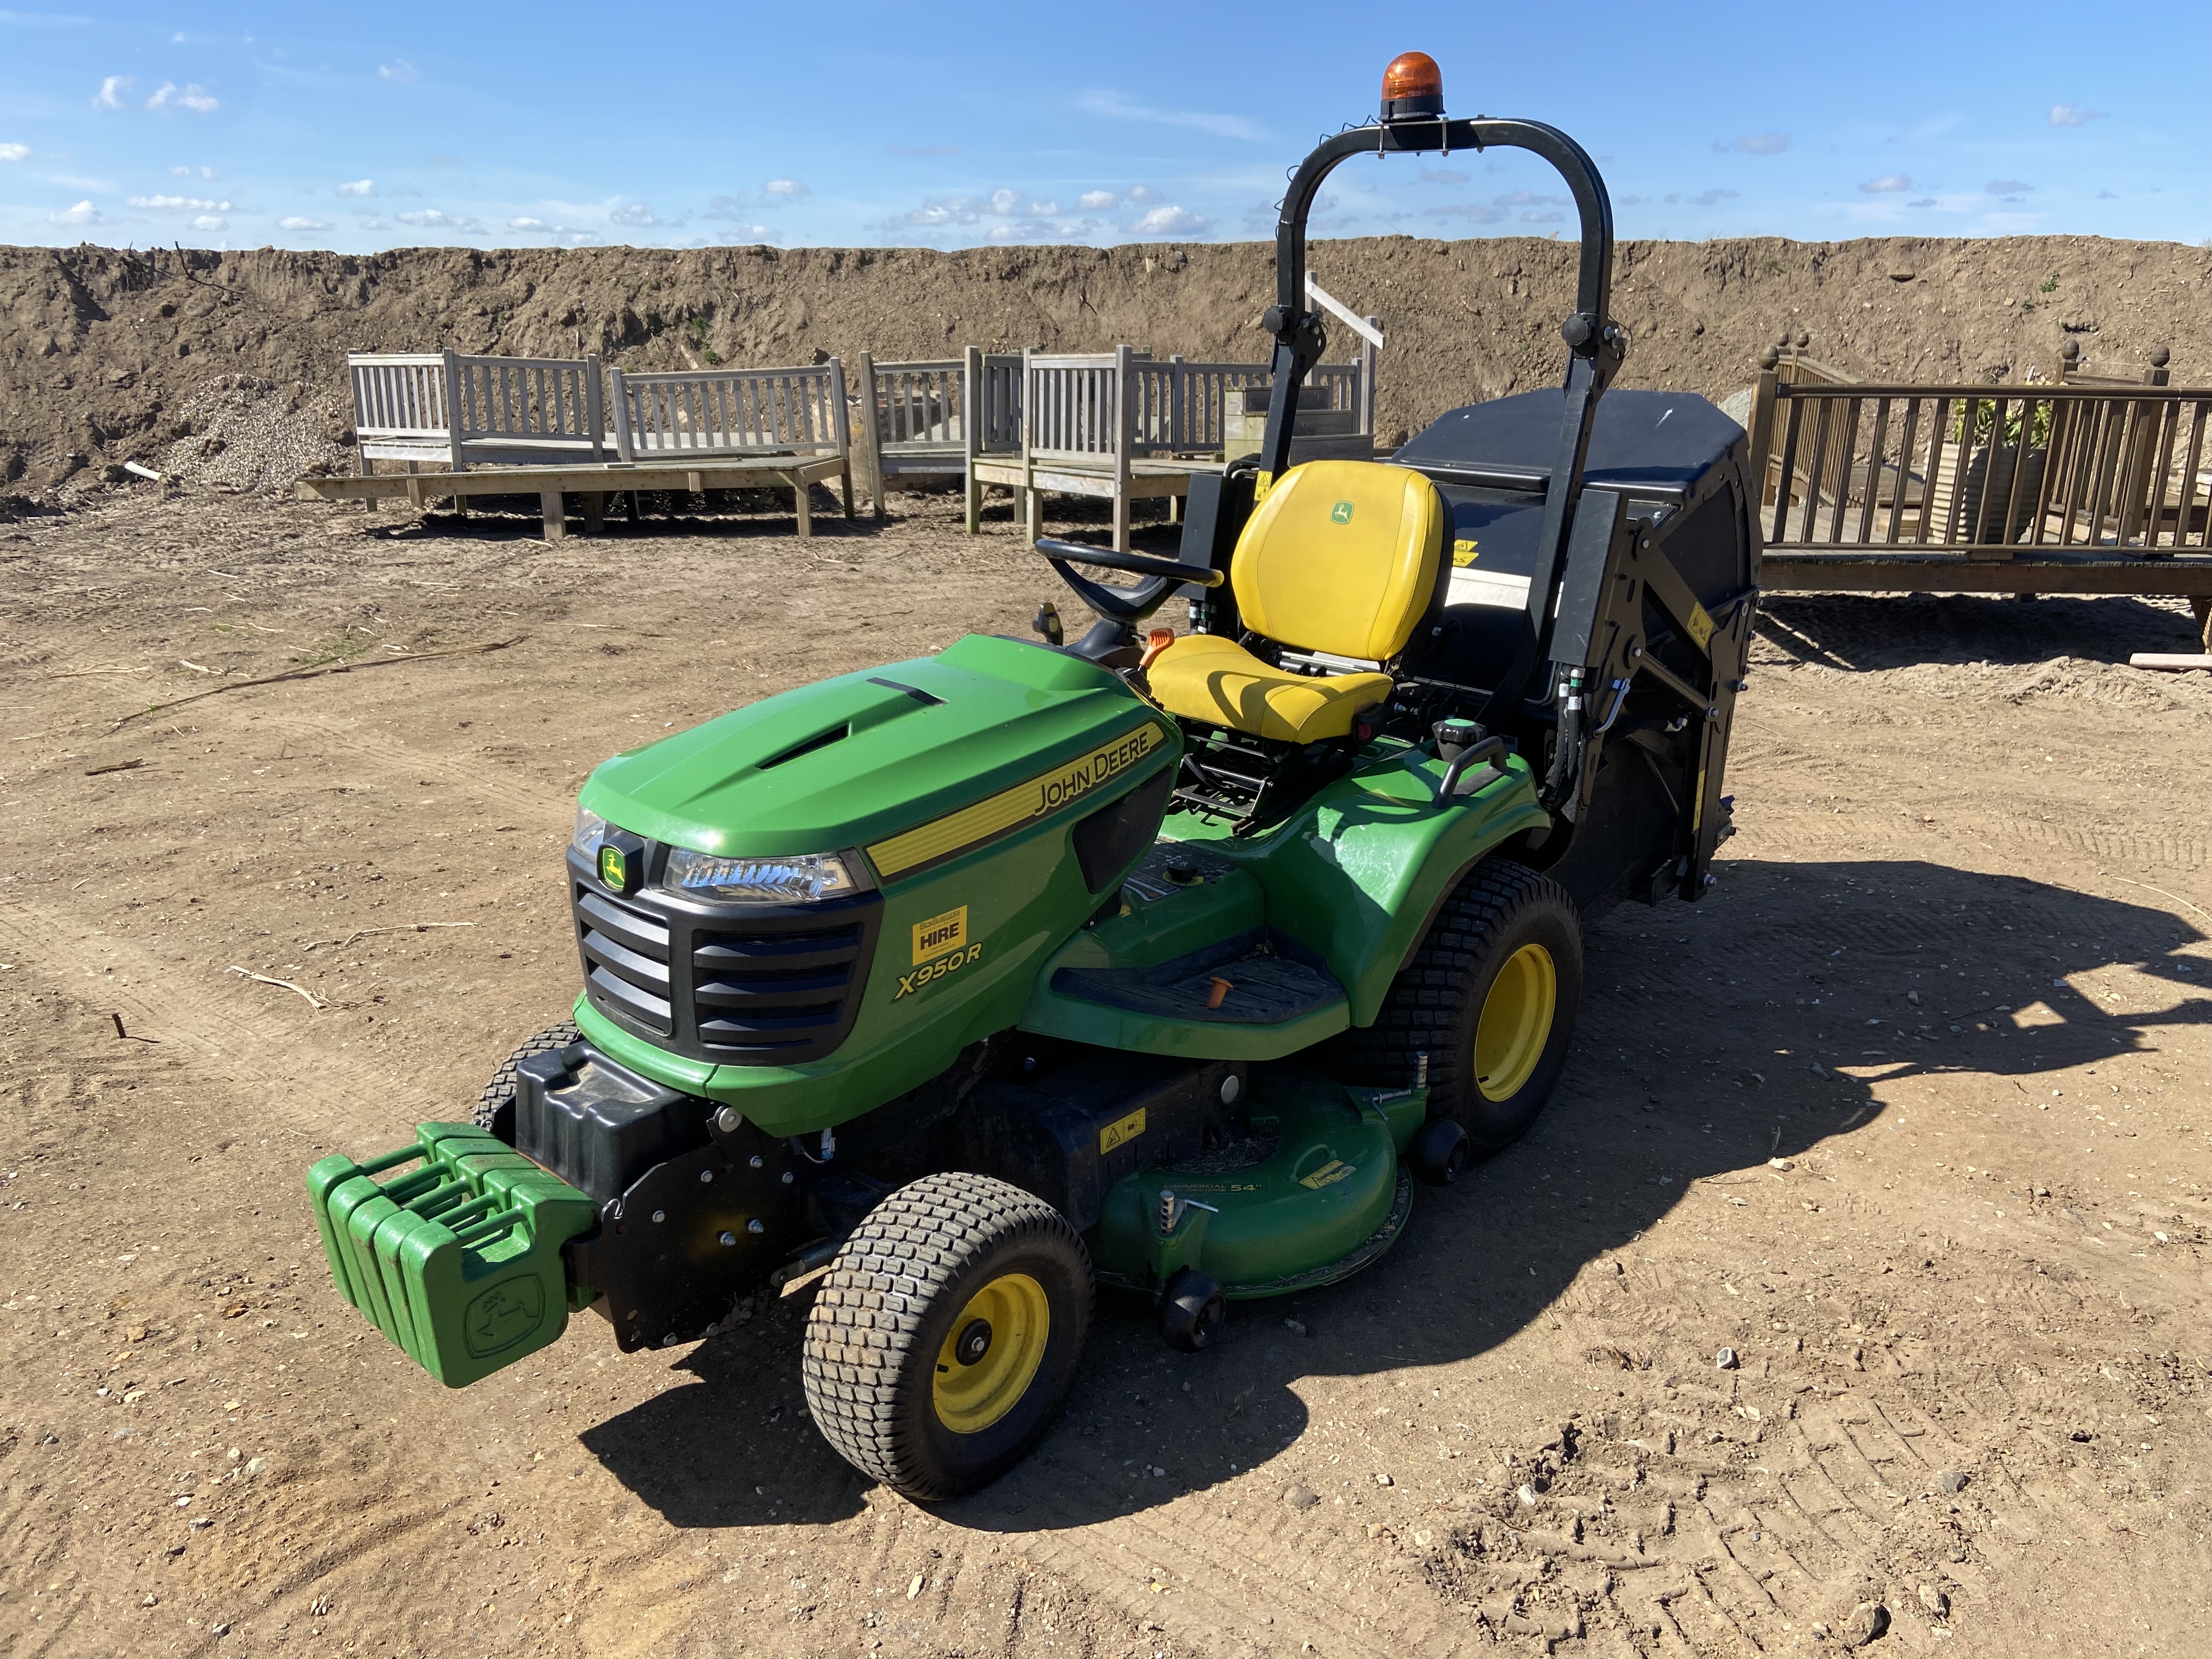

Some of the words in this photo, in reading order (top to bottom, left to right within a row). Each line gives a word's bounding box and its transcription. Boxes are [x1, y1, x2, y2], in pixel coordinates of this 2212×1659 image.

[1035, 766, 1091, 814] JOHN
[1093, 731, 1149, 781] DEERE
[920, 922, 960, 950] HIRE
